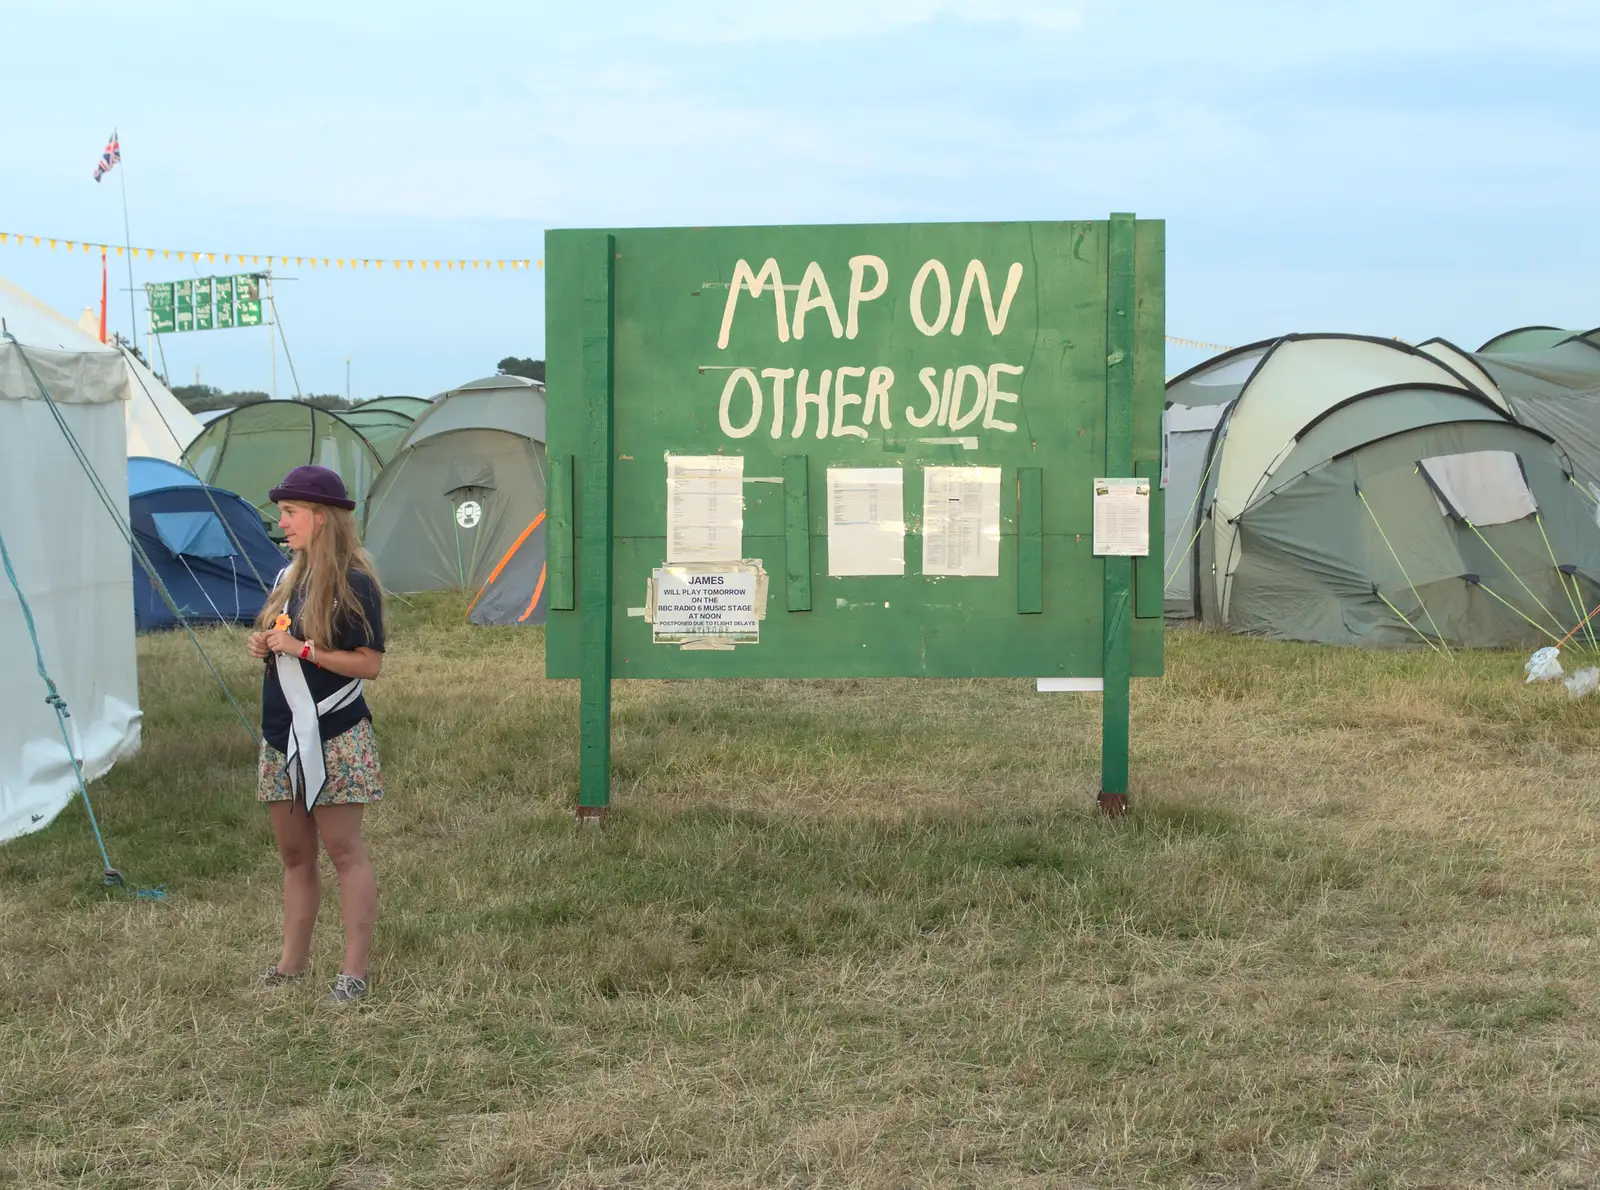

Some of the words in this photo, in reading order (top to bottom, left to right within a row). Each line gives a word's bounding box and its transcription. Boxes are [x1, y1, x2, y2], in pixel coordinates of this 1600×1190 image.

[717, 255, 888, 349] MAP
[910, 259, 1023, 336] ON
[719, 366, 894, 439] OTHER
[905, 363, 1024, 433] SIDE
[688, 576, 724, 585] JAMES
